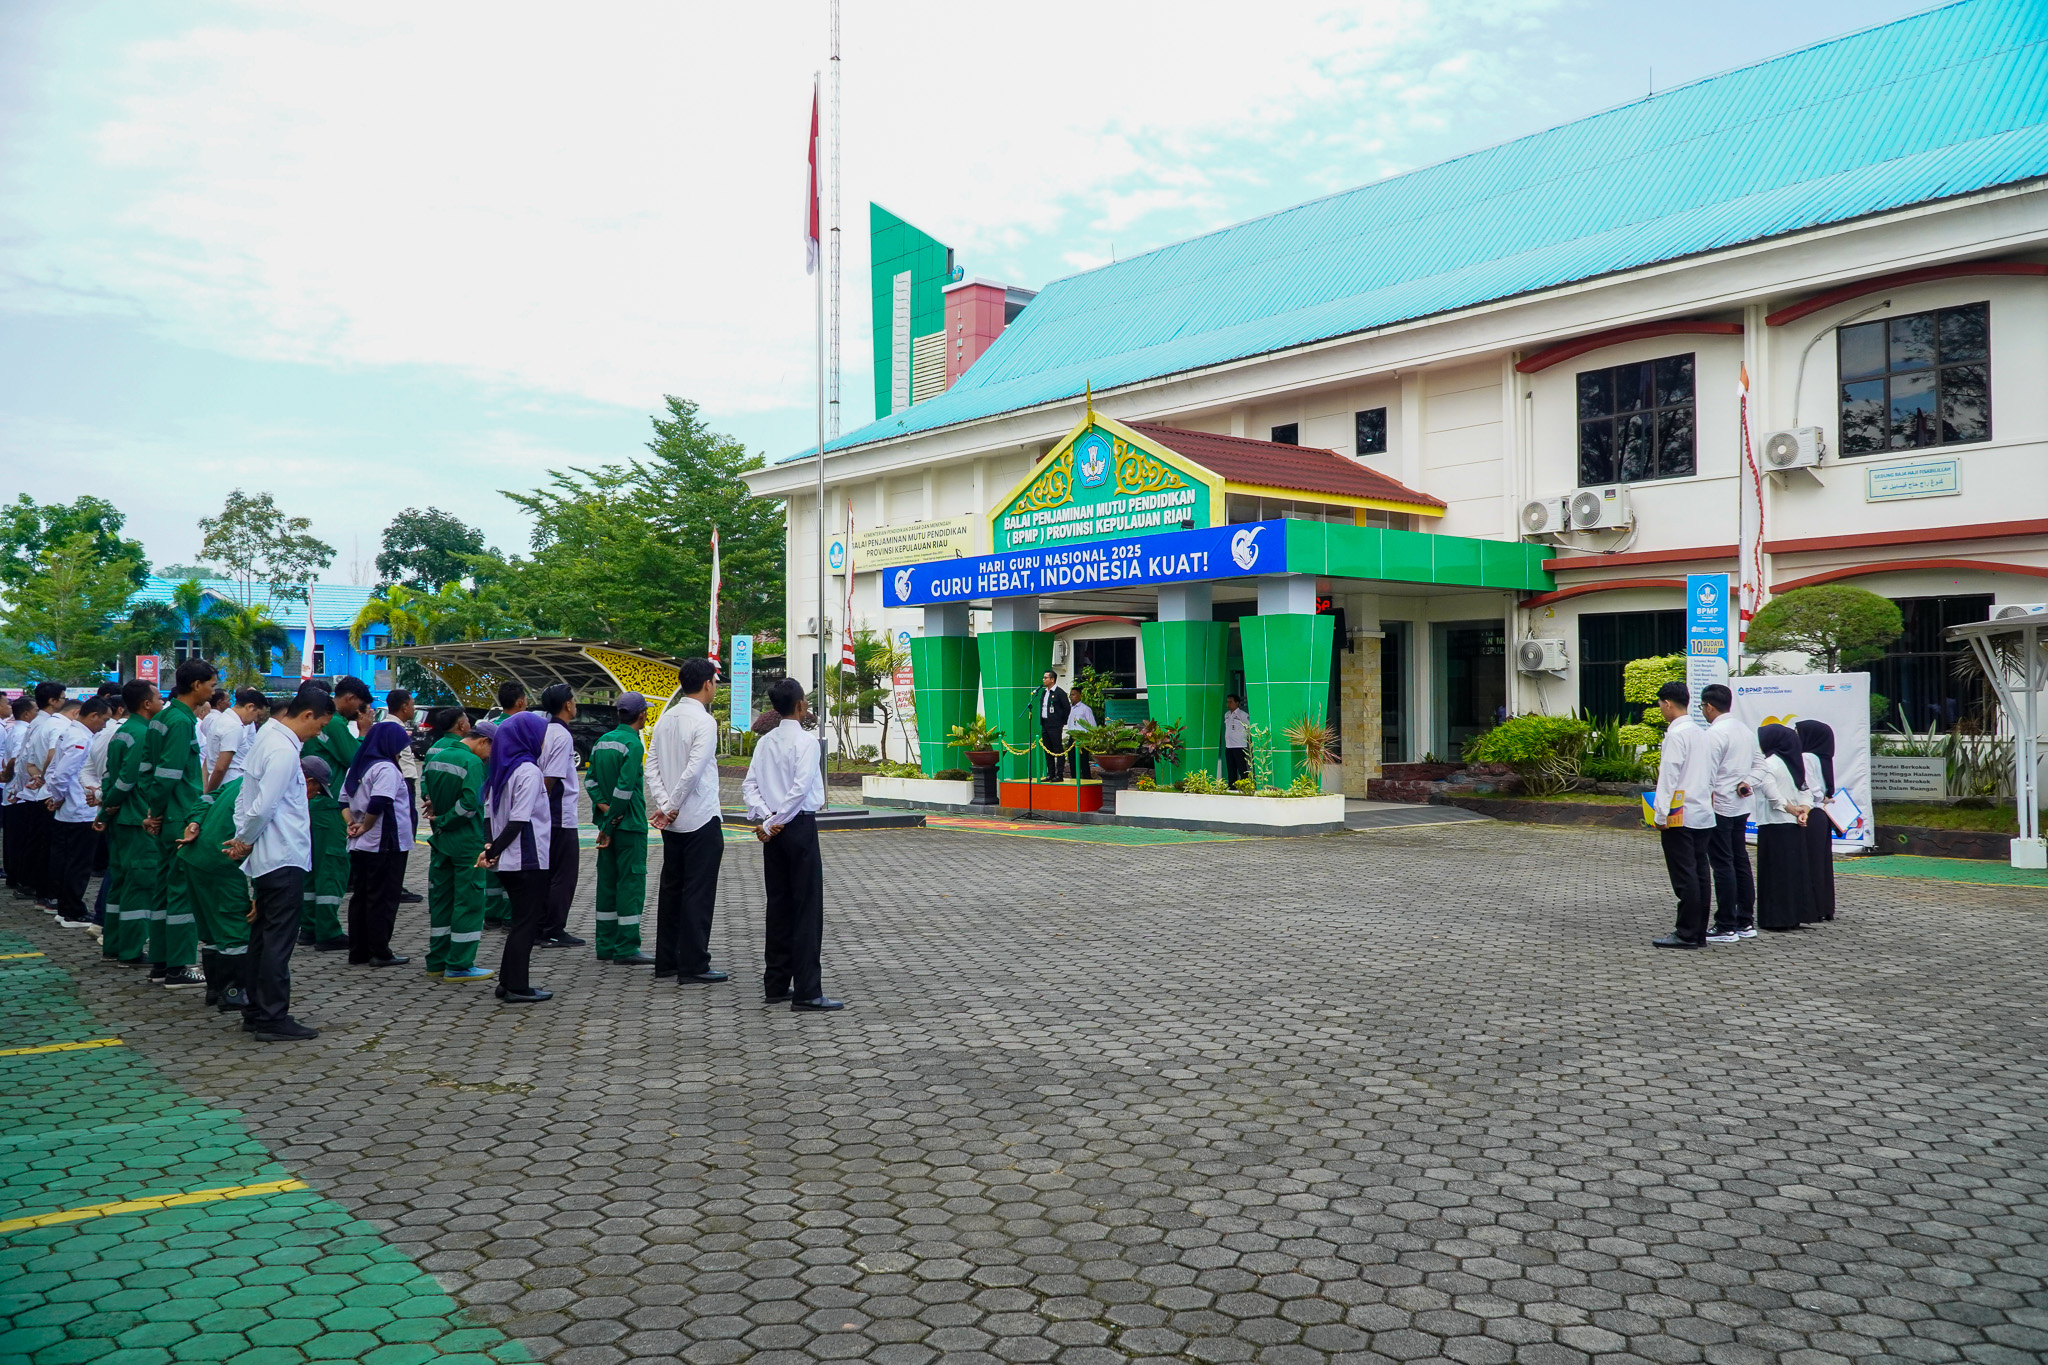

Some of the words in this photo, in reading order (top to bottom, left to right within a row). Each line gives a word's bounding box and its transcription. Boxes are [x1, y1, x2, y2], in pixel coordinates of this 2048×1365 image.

[1004, 514, 1030, 531] BALAI
[1032, 504, 1094, 526] PENJAMINAN
[1096, 500, 1126, 517] MUTU
[1128, 489, 1196, 512] PENDIDIKAN
[1046, 521, 1093, 541] PROVINSI
[1096, 511, 1160, 534] KEPULAUAN
[1163, 507, 1192, 524] RIAU
[866, 548, 894, 557] PROVINSI
[895, 542, 932, 554] KEPULAUAN
[933, 540, 948, 548] RIAU
[867, 534, 906, 547] PENJAMINAN
[908, 532, 925, 541] MUTU
[927, 526, 967, 539] PENDIDIKAN
[931, 577, 972, 597] GURU
[977, 570, 1035, 593] HEBAT,
[1040, 559, 1142, 587] INDONESIA
[1148, 551, 1209, 576] KUAT!
[979, 561, 1005, 574] HARI
[1010, 558, 1040, 571] GURU
[1045, 549, 1104, 568] NASIONAL
[1111, 544, 1142, 559] 2025
[1692, 640, 1702, 653] 10
